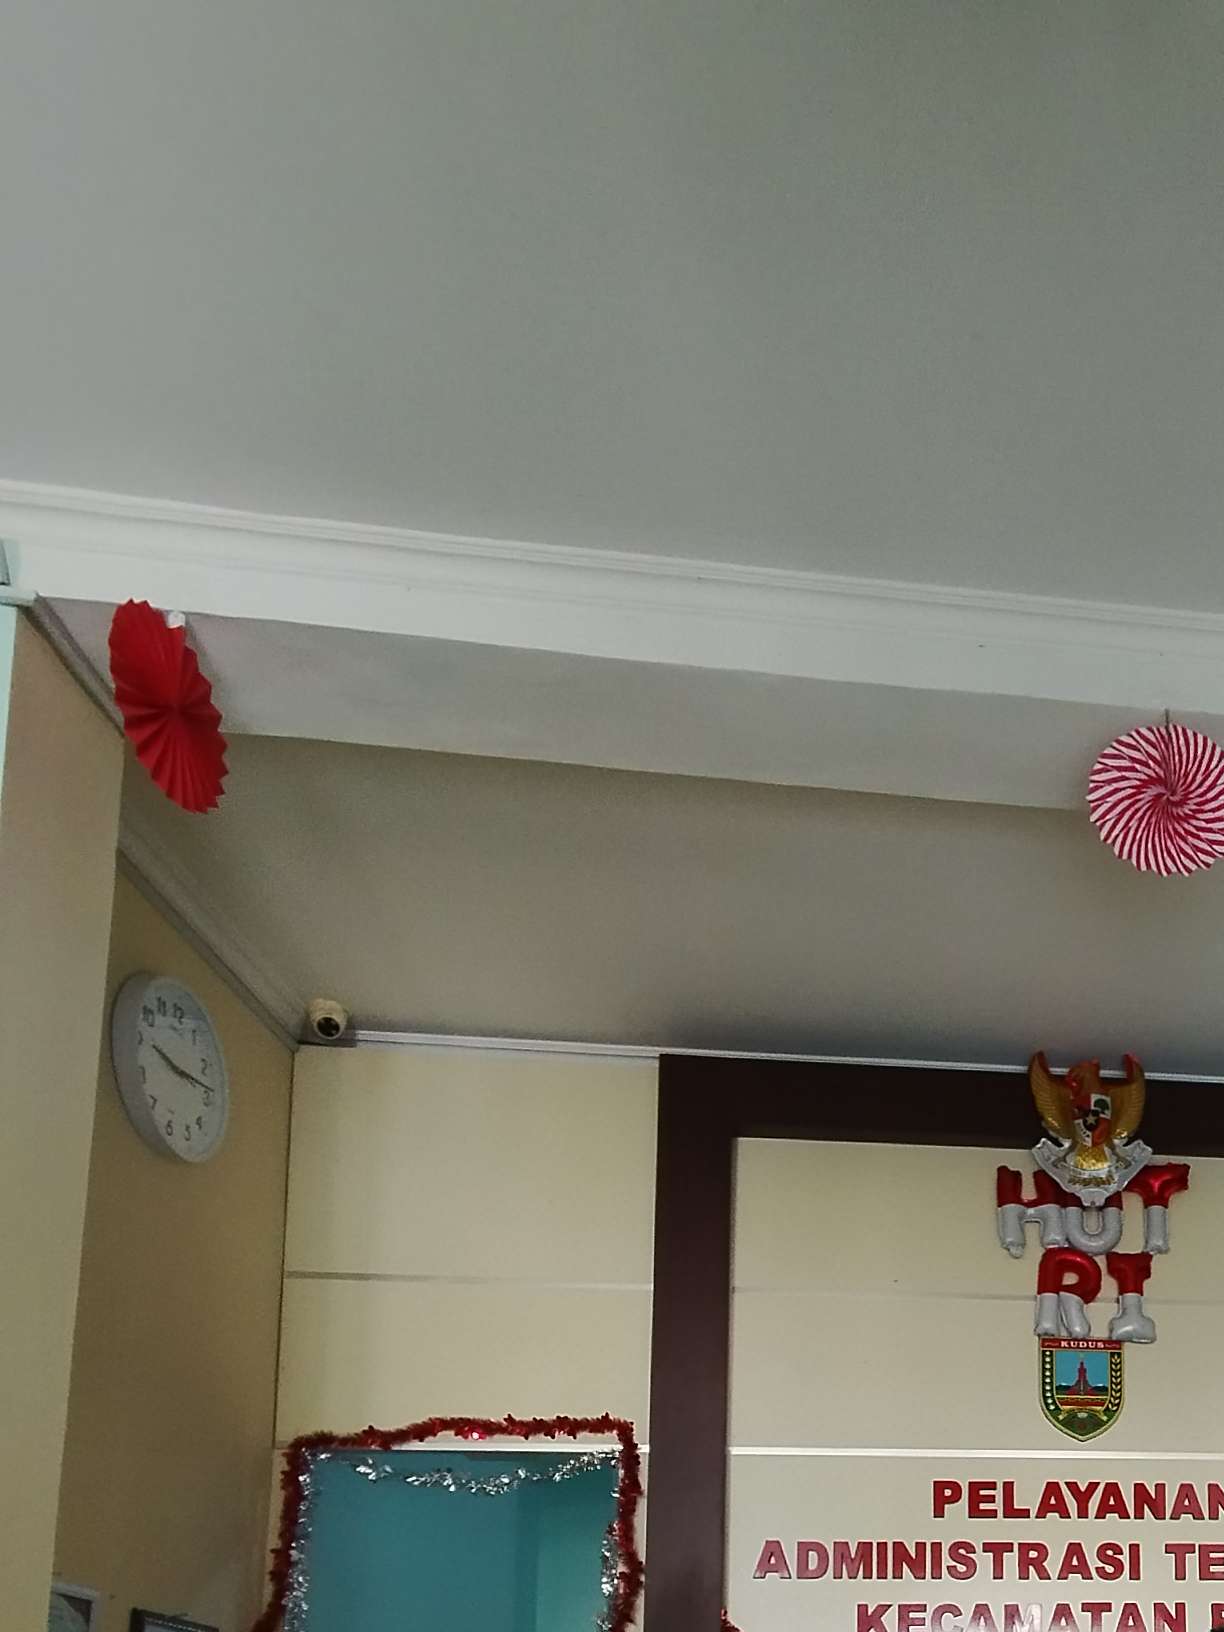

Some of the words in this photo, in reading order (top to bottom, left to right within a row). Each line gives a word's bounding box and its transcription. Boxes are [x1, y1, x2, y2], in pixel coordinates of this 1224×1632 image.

[997, 1163, 1190, 1258] HUT
[1035, 1248, 1156, 1344] RI
[1060, 1340, 1105, 1349] KUDUS
[753, 1540, 1141, 1581] ADMINISTRASI
